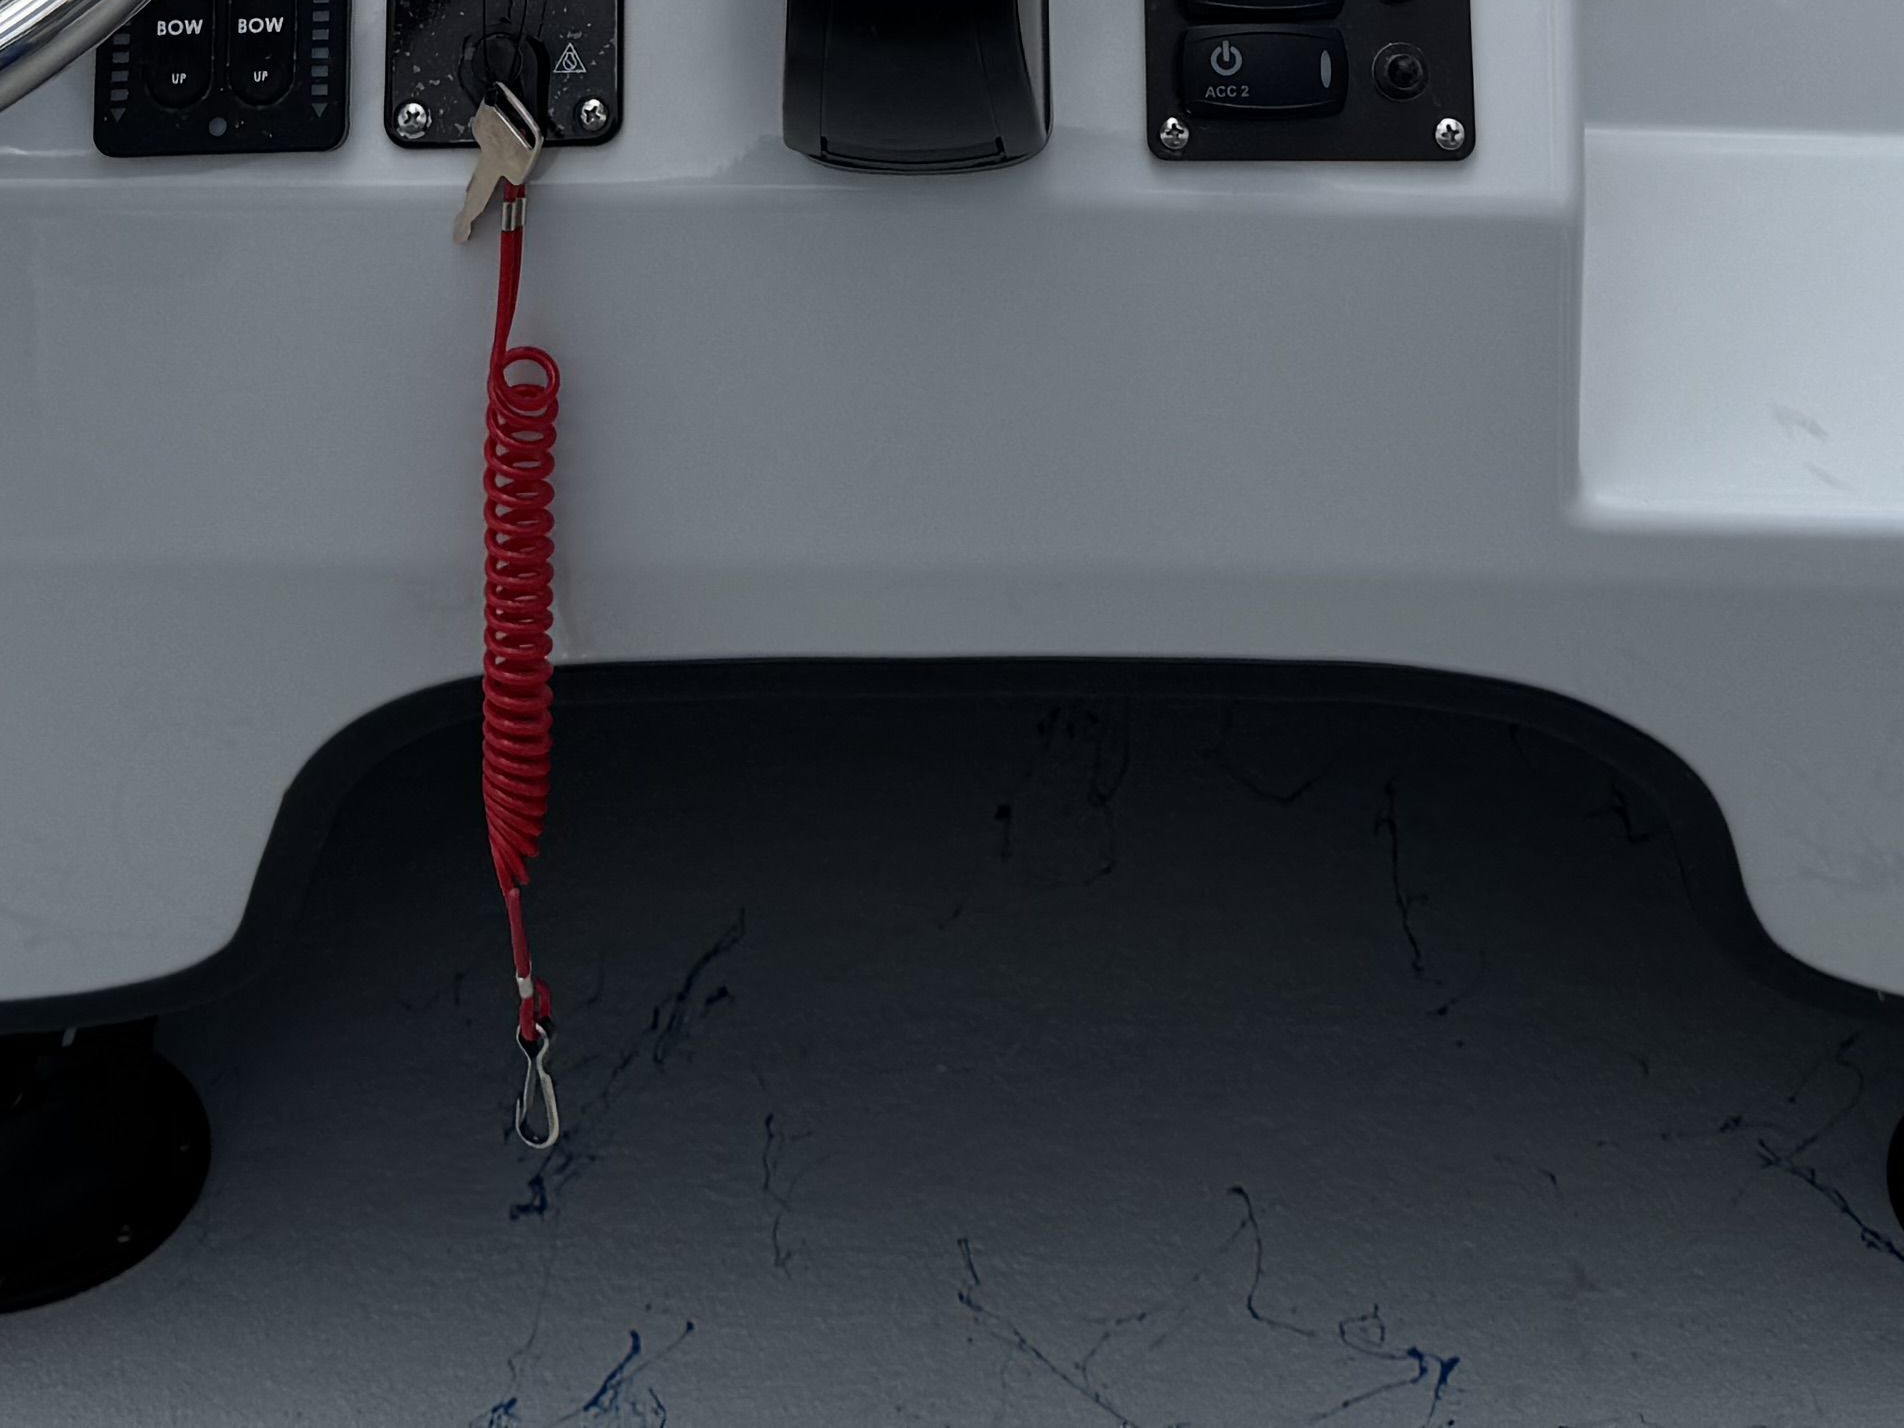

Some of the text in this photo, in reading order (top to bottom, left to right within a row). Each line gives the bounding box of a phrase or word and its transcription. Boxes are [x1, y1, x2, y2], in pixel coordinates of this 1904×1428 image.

[156, 19, 204, 36] BOW
[237, 16, 284, 34] BOW
[171, 72, 187, 84] UP
[253, 70, 269, 83] UP
[1205, 85, 1250, 98] ACC 2
